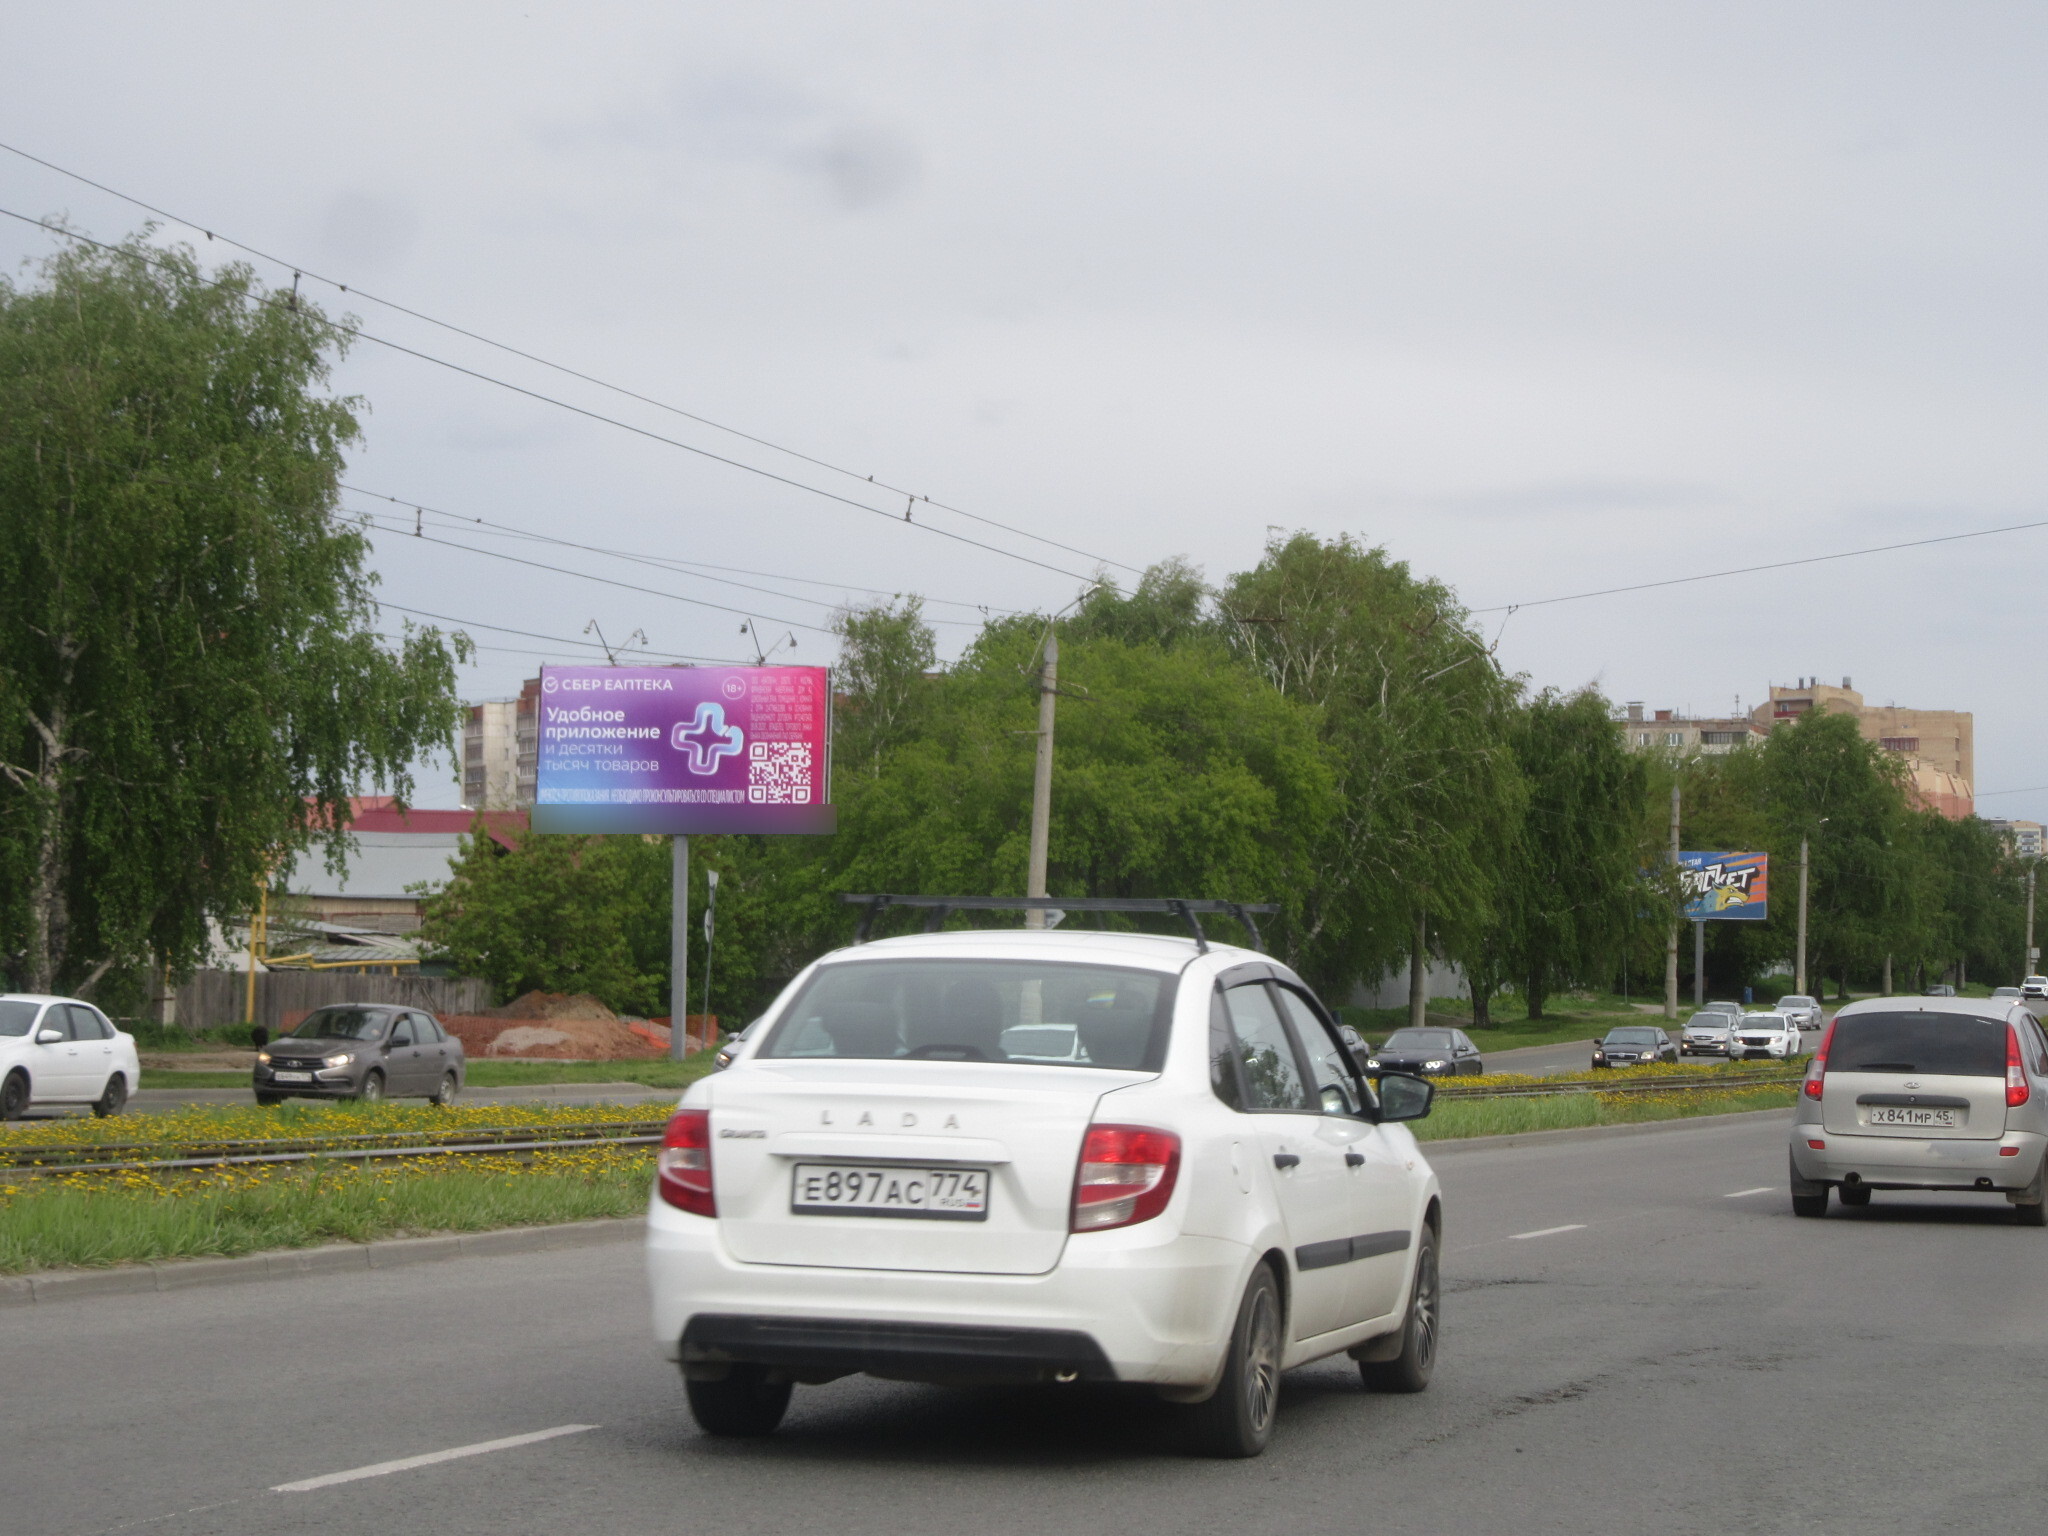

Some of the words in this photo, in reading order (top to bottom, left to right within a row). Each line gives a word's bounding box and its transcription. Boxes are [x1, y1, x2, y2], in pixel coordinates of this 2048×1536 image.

[562, 679, 601, 690] СБЕР
[604, 679, 673, 691] ЕАПТЕКА
[726, 684, 742, 693] 18+
[546, 706, 625, 723] Удобное
[545, 726, 660, 741] приложение
[545, 745, 555, 754] и
[558, 744, 623, 755] десятки
[545, 760, 589, 771] тысяч
[594, 760, 659, 773] товаров
[821, 1110, 959, 1129] LADA
[1878, 1109, 1931, 1123] Х841МР
[1935, 1111, 1949, 1121] 45
[805, 1172, 924, 1204] Е897АС
[930, 1173, 981, 1197] 774
